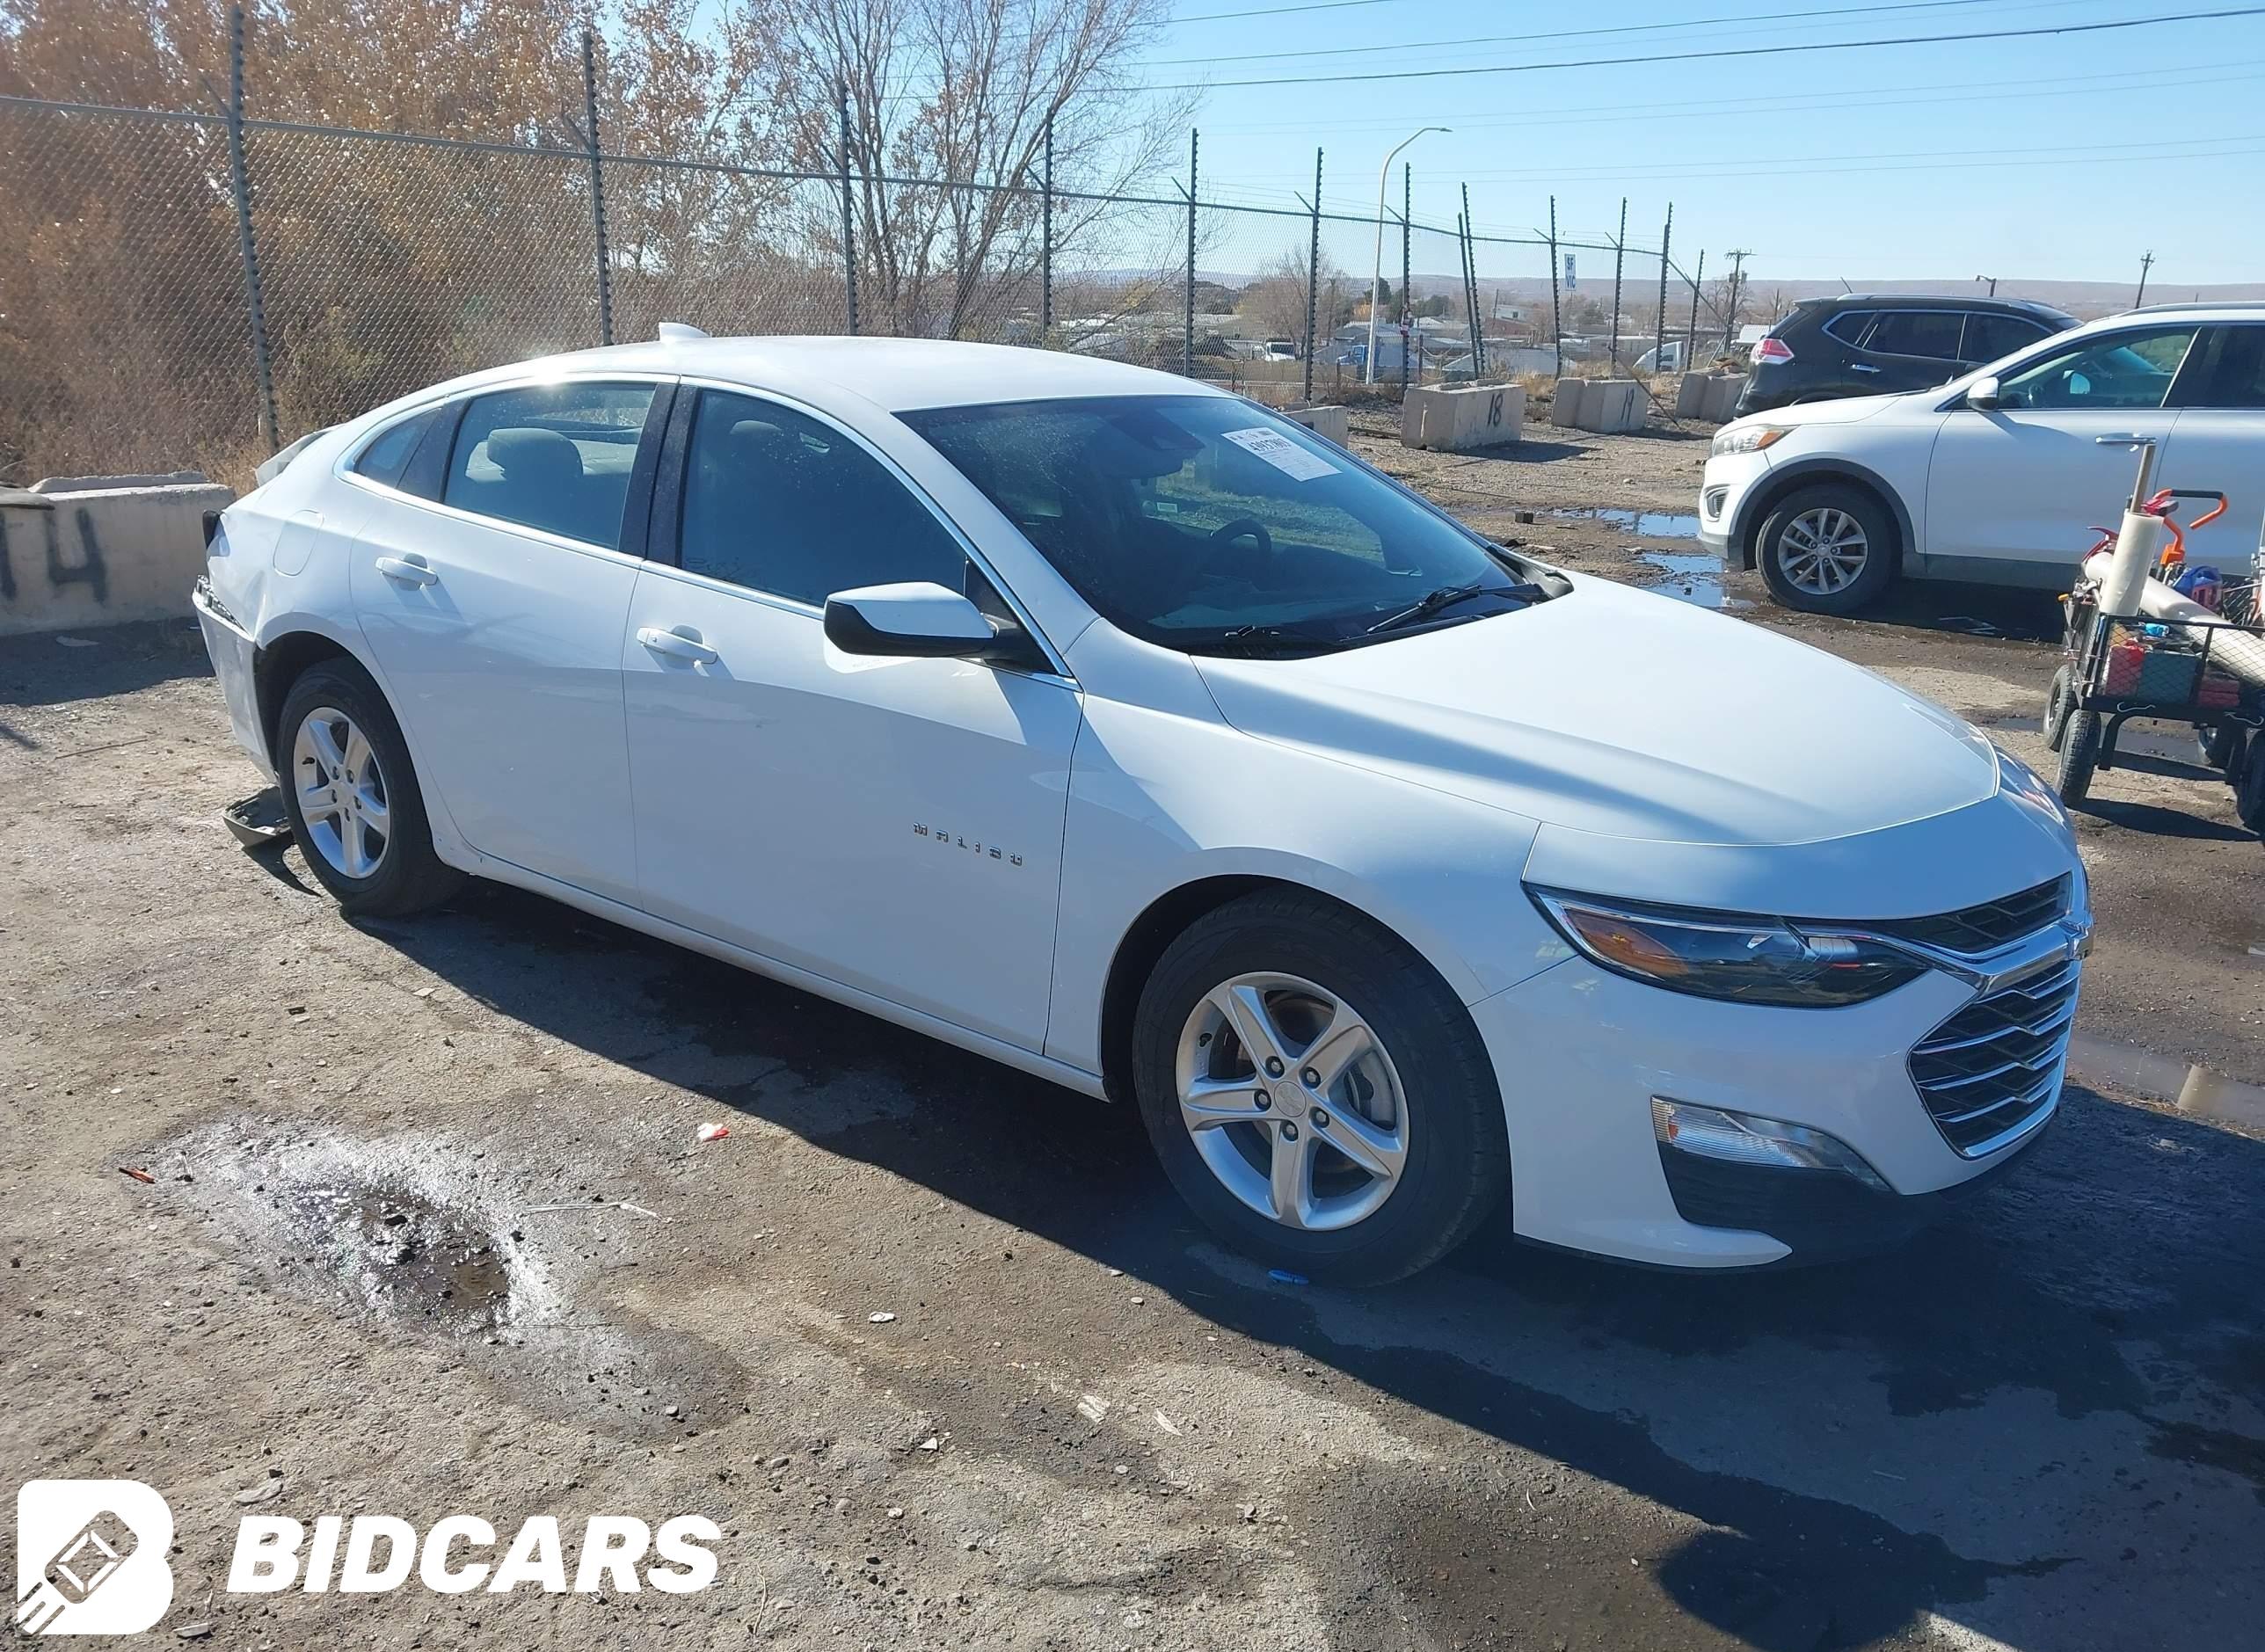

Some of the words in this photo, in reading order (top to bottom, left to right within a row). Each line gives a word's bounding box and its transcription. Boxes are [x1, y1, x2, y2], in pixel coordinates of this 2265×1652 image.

[1487, 393, 1504, 427] 18
[1620, 388, 1635, 423] 19
[913, 822, 1023, 867] MALIBU
